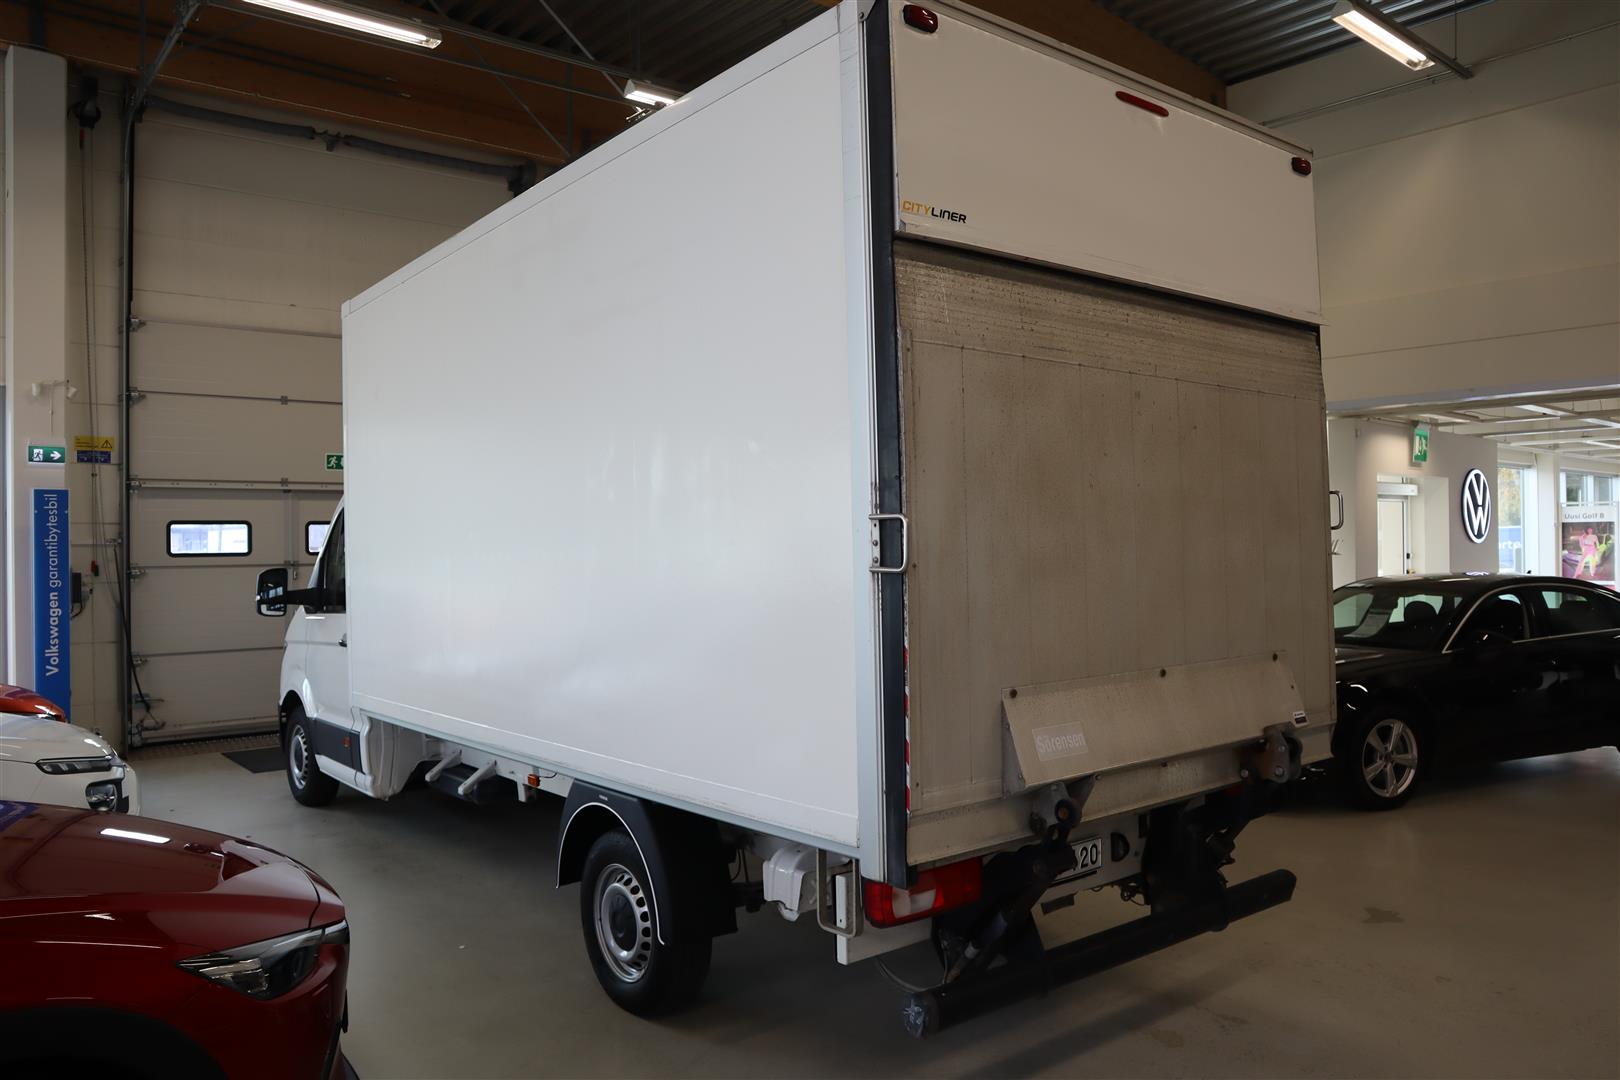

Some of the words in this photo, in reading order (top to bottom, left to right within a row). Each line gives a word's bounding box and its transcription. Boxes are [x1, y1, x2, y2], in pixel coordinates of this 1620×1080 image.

[902, 200, 967, 223] CITYLINER
[44, 494, 61, 588] garantibytesbil
[45, 592, 61, 676] Volkswagen
[1074, 843, 1098, 870] 20
